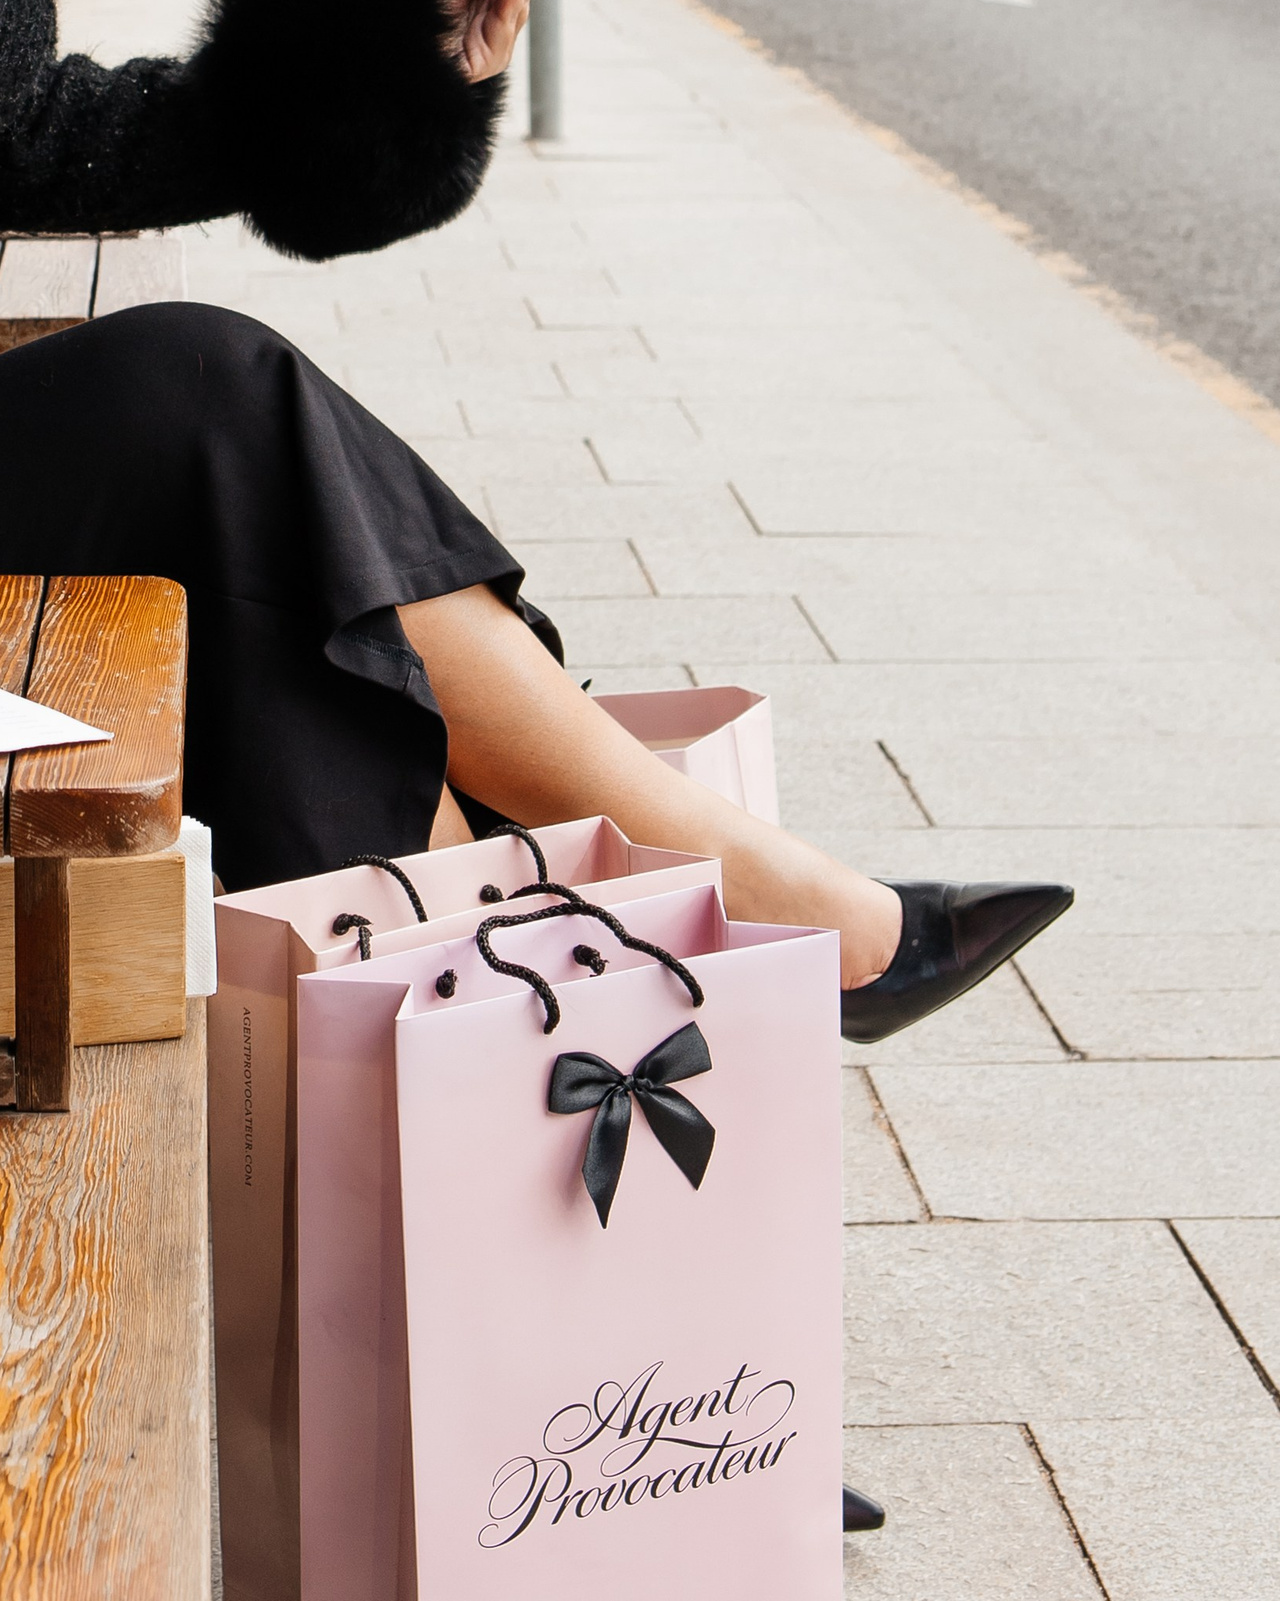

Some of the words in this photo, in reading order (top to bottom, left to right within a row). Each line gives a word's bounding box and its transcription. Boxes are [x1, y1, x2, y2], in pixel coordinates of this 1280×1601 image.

[242, 1006, 254, 1187] AGENTPROVOCATEUR.COM
[542, 1360, 796, 1478] Agent
[477, 1429, 798, 1550] Provocateur
